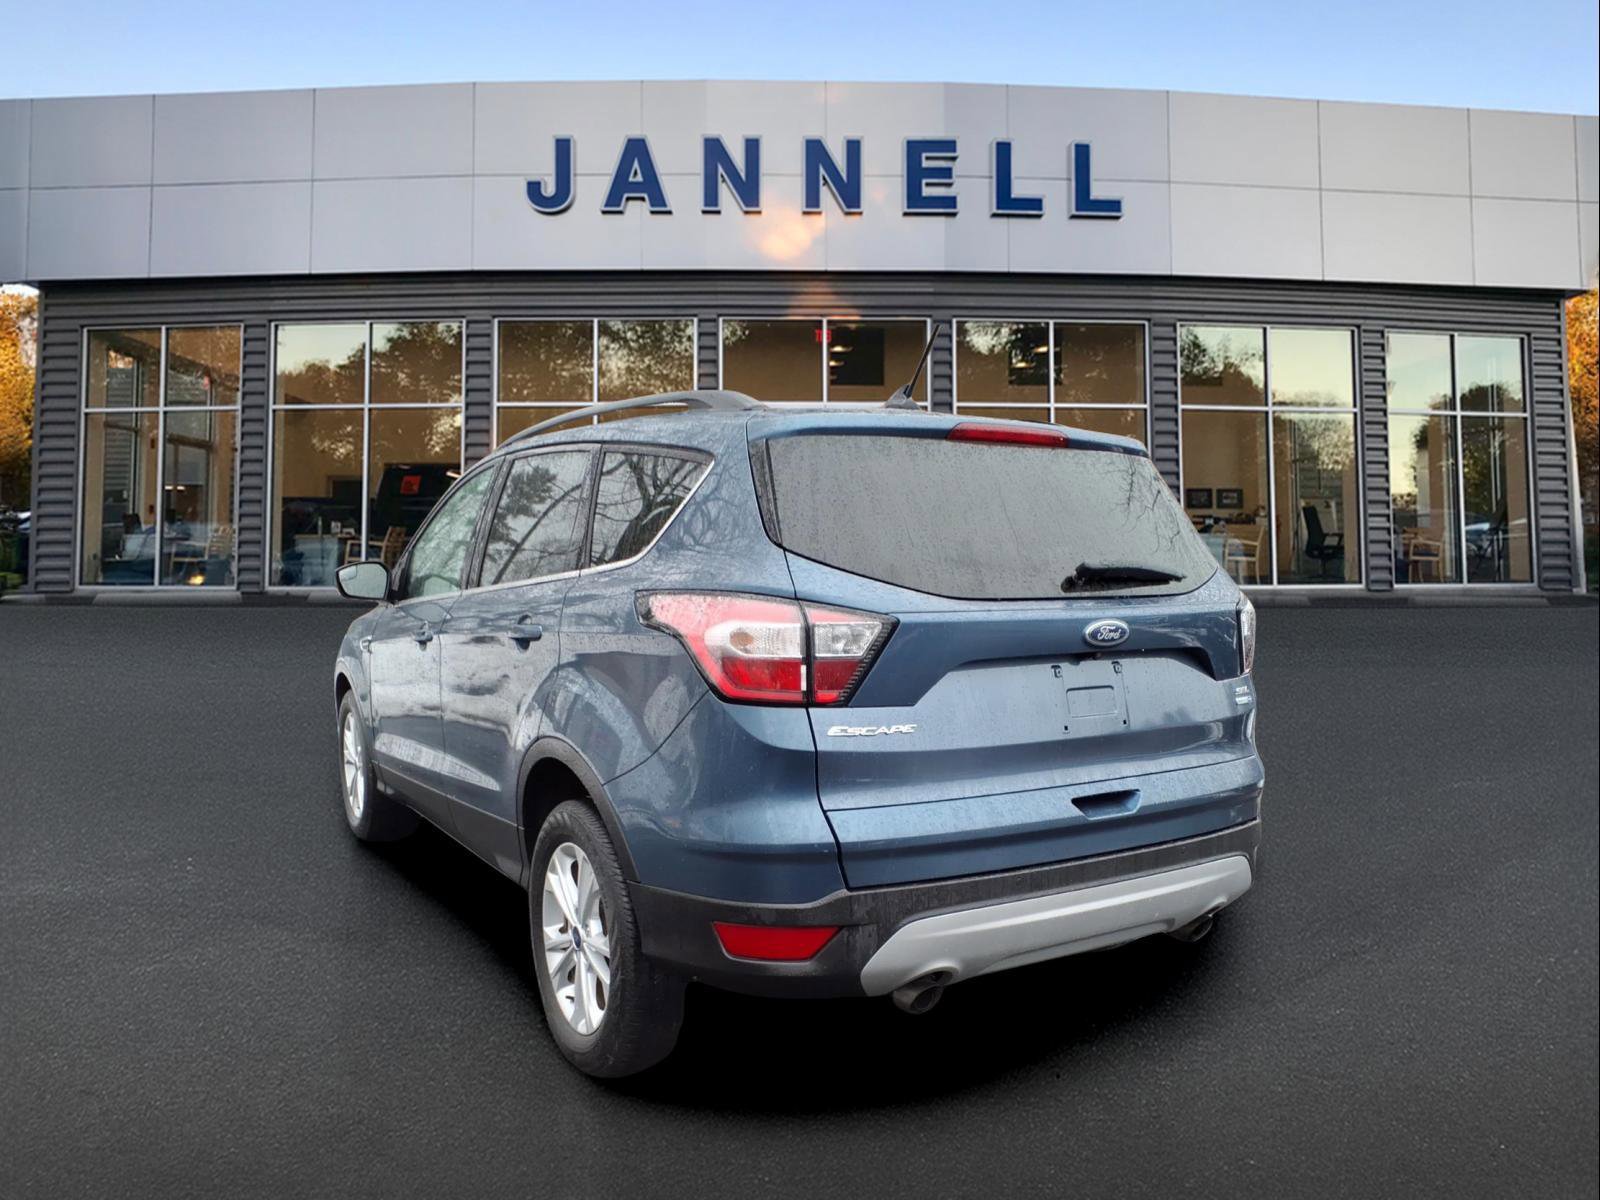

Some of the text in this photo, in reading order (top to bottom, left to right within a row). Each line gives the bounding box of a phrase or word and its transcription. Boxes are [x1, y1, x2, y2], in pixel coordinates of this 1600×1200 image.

[525, 134, 1123, 219] JANNELL
[1097, 625, 1122, 640] Ford
[826, 723, 918, 737] ESCAPE
